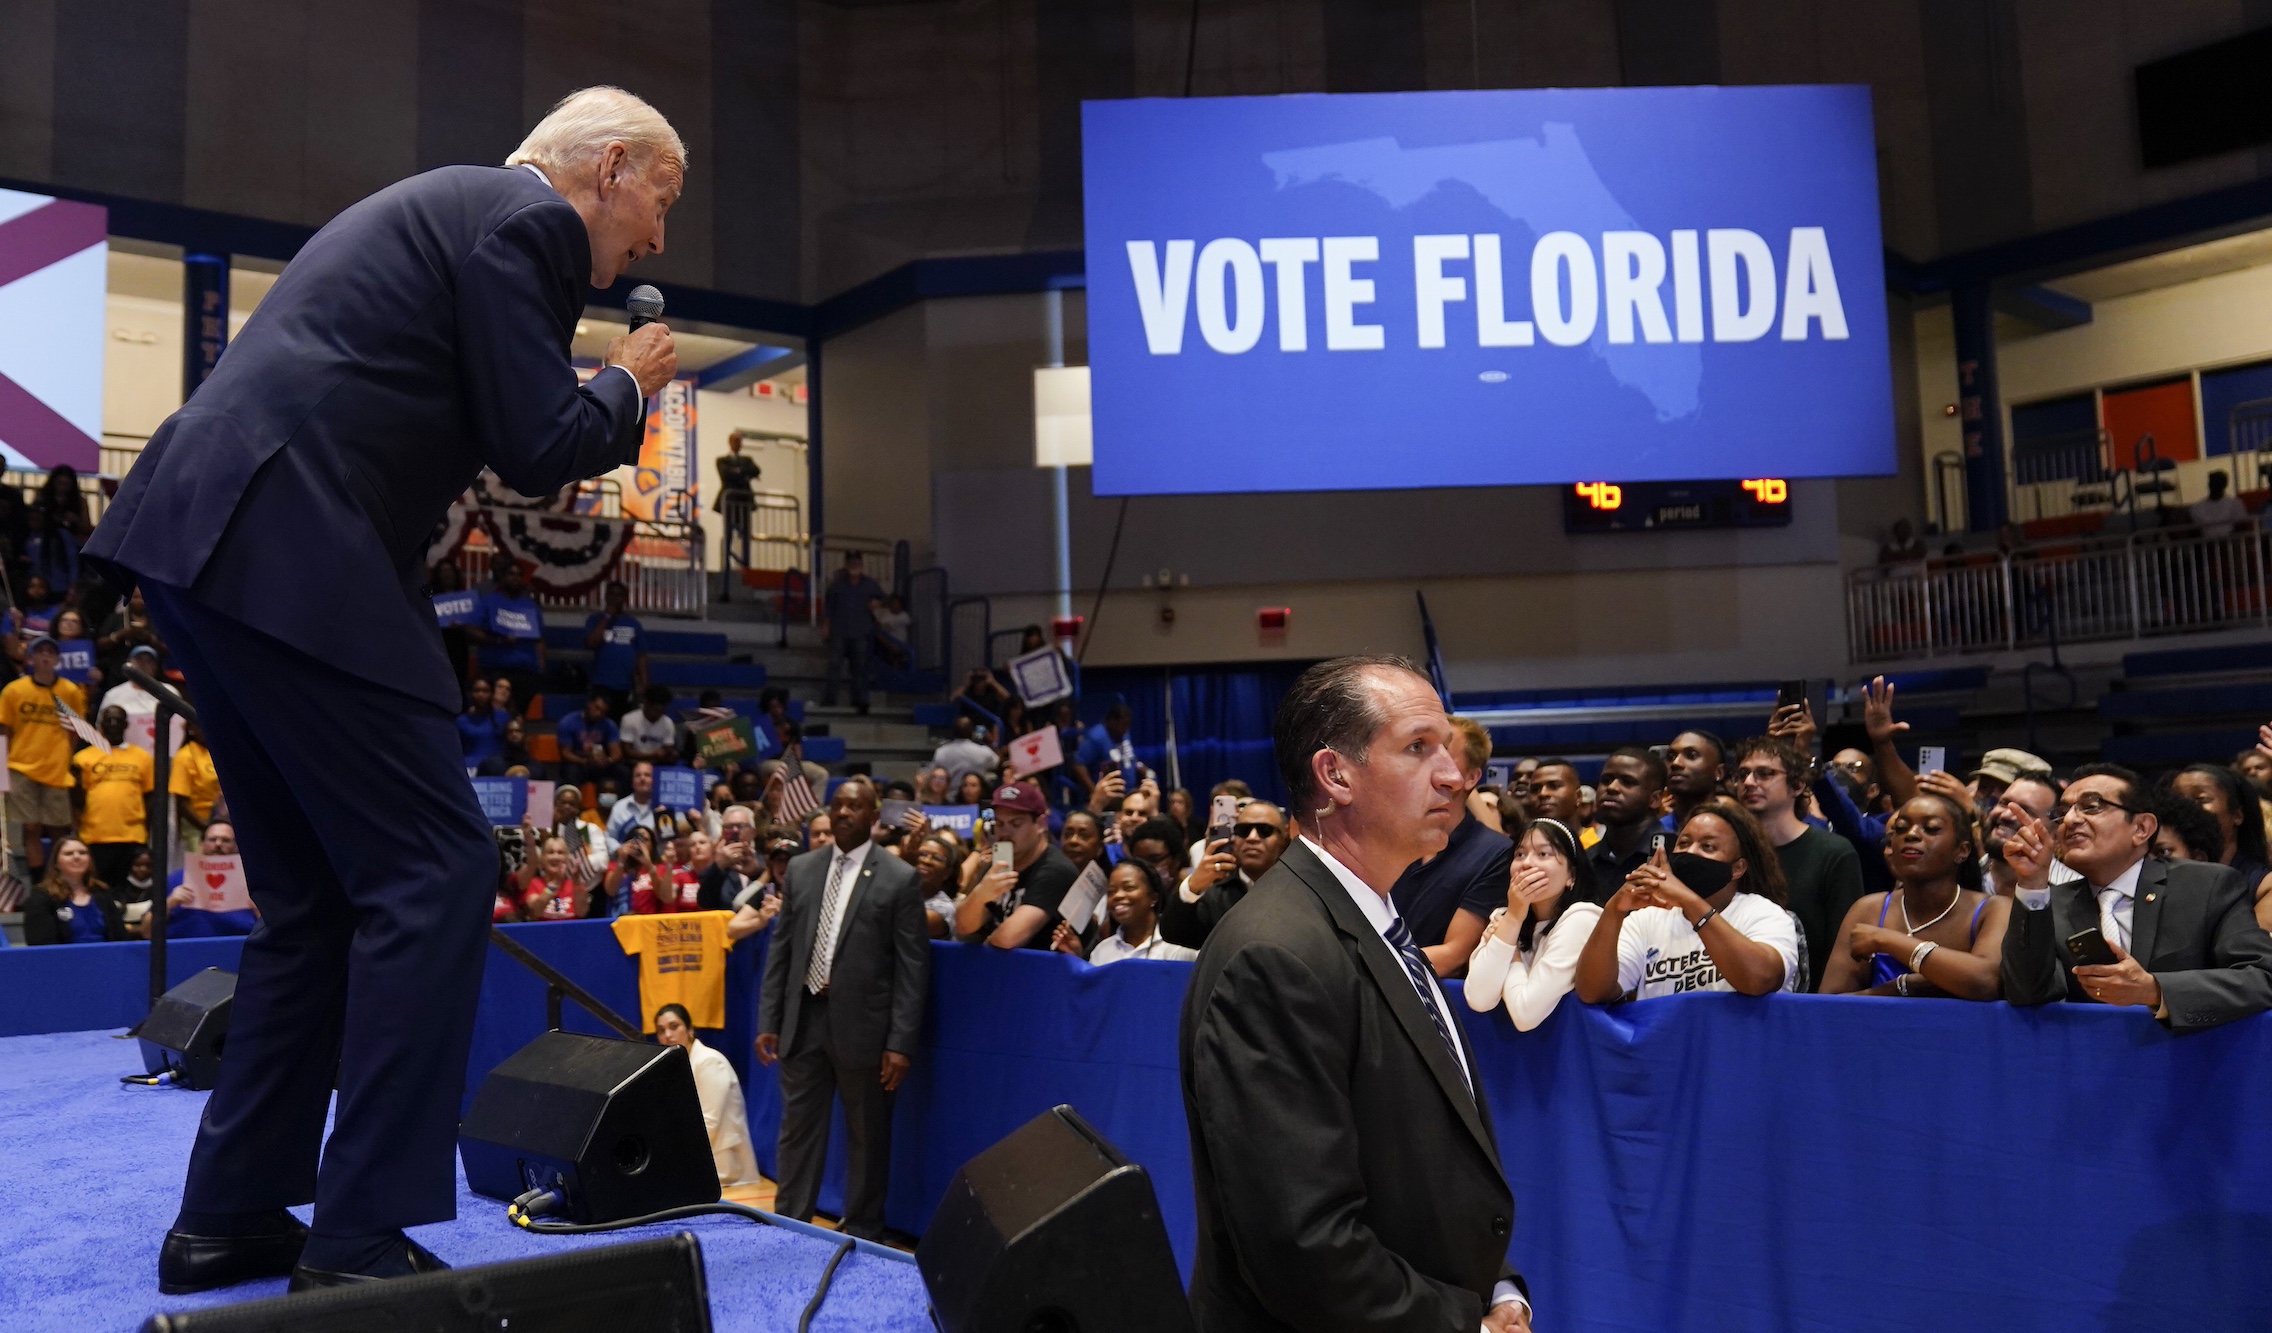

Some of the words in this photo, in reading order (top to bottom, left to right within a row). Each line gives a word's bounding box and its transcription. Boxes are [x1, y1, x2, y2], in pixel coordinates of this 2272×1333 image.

[1126, 237, 1385, 355] VOTE
[1414, 226, 1850, 349] FLORIDA
[1659, 504, 1701, 523] period
[434, 598, 474, 618] VOTE!
[56, 650, 90, 670] TE!
[929, 812, 972, 831] VOTE!
[1646, 950, 1711, 977] VOTERS
